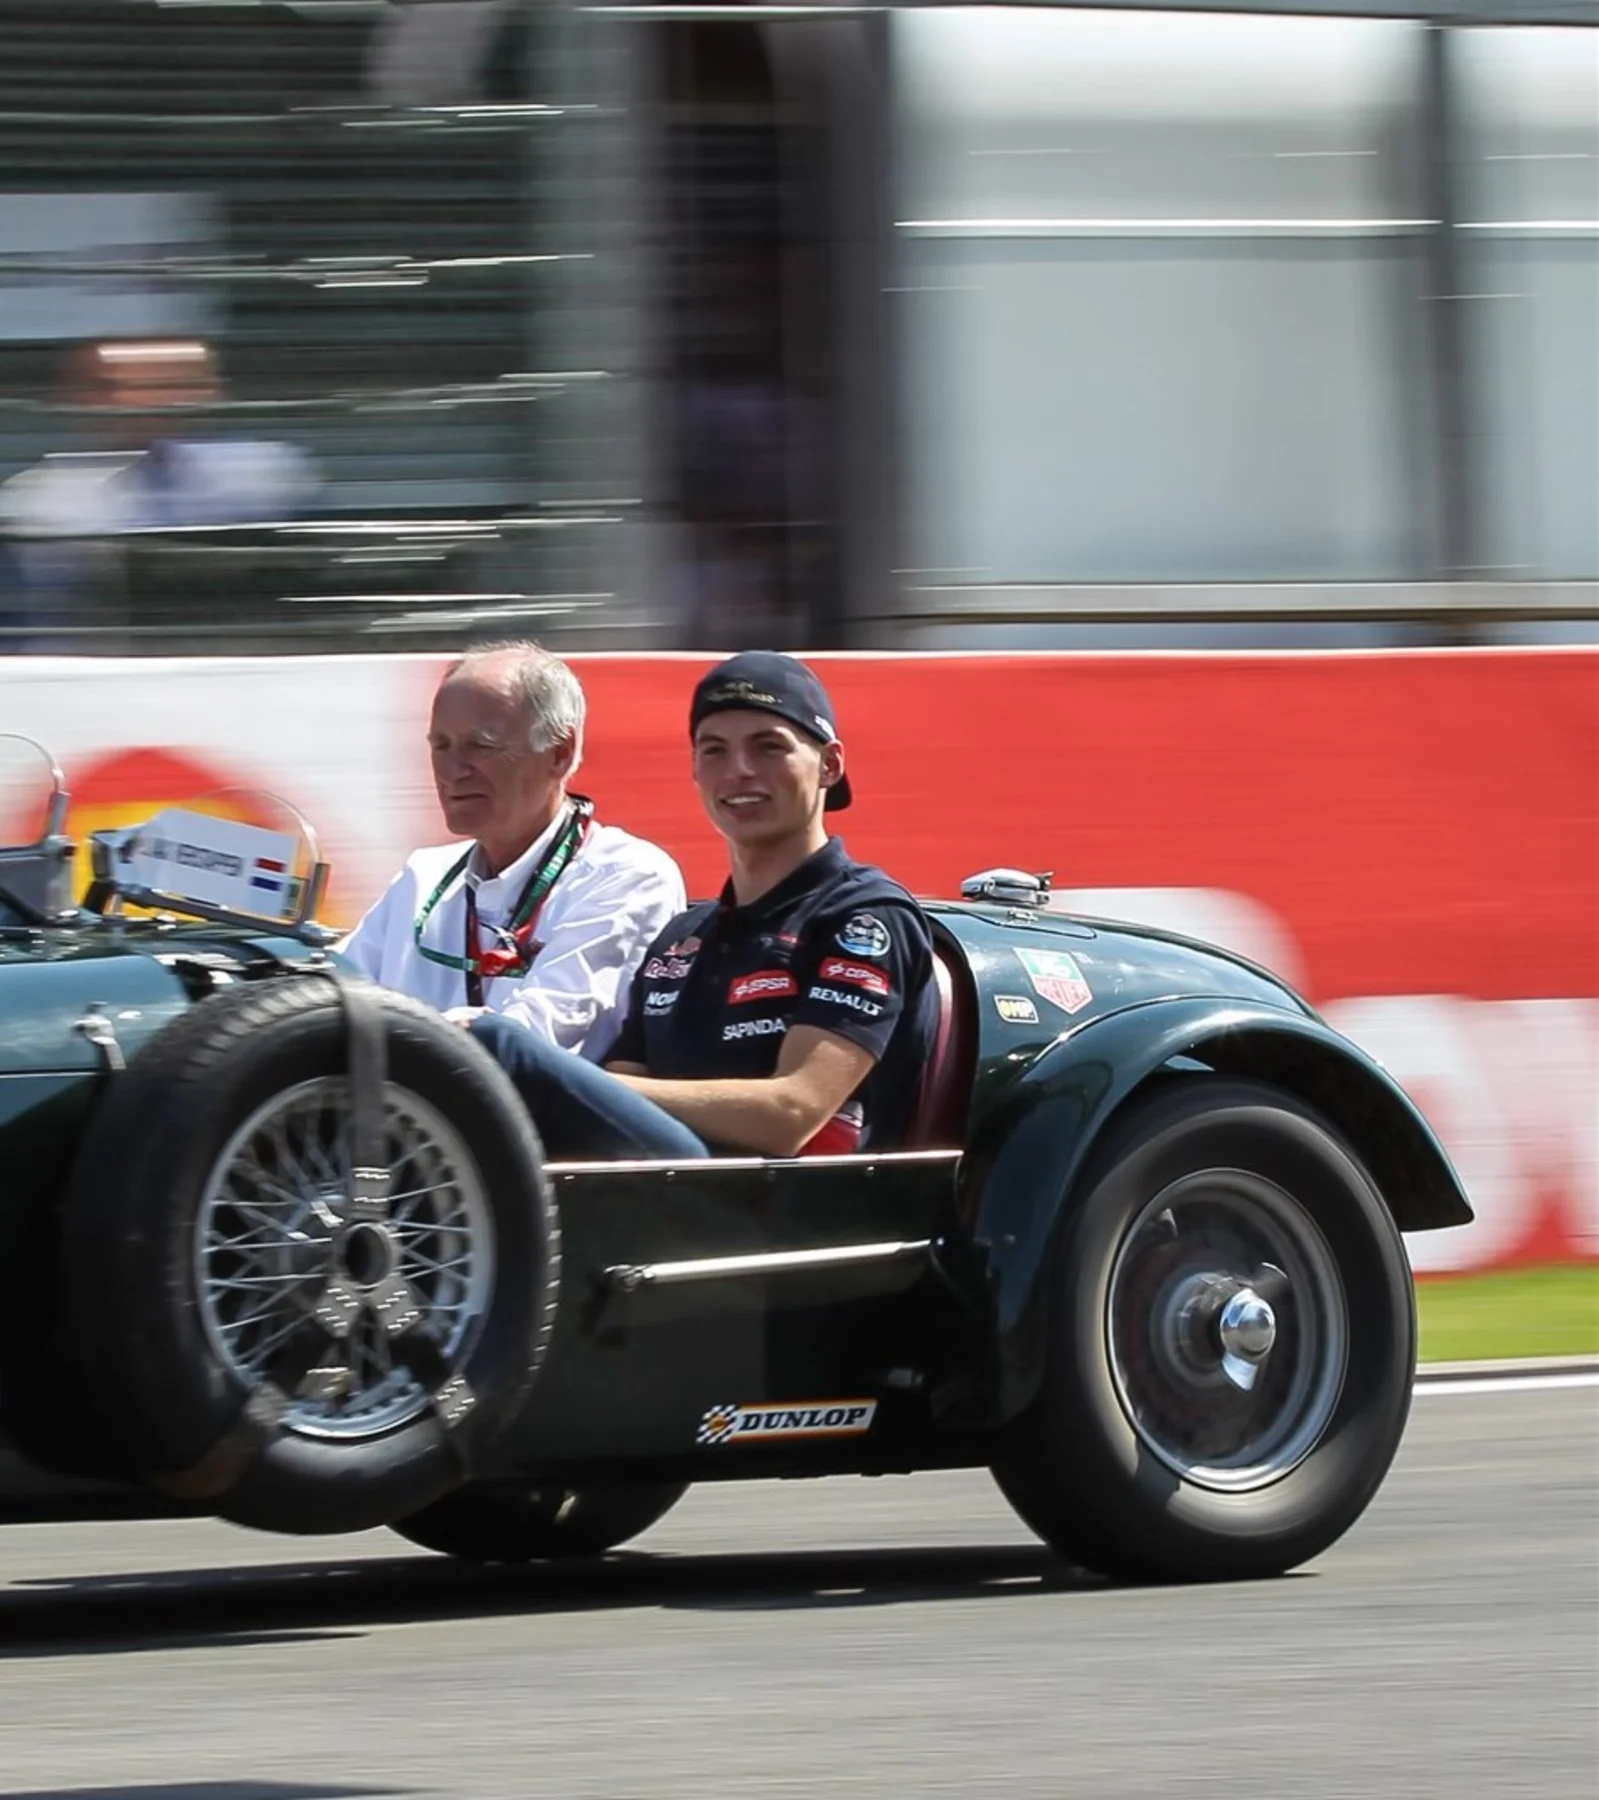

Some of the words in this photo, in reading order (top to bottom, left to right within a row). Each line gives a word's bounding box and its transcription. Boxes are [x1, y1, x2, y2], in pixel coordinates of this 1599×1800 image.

[808, 986, 883, 1016] RENAULT
[722, 1017, 787, 1041] SAPINDA
[739, 1406, 868, 1432] DUNLOP
